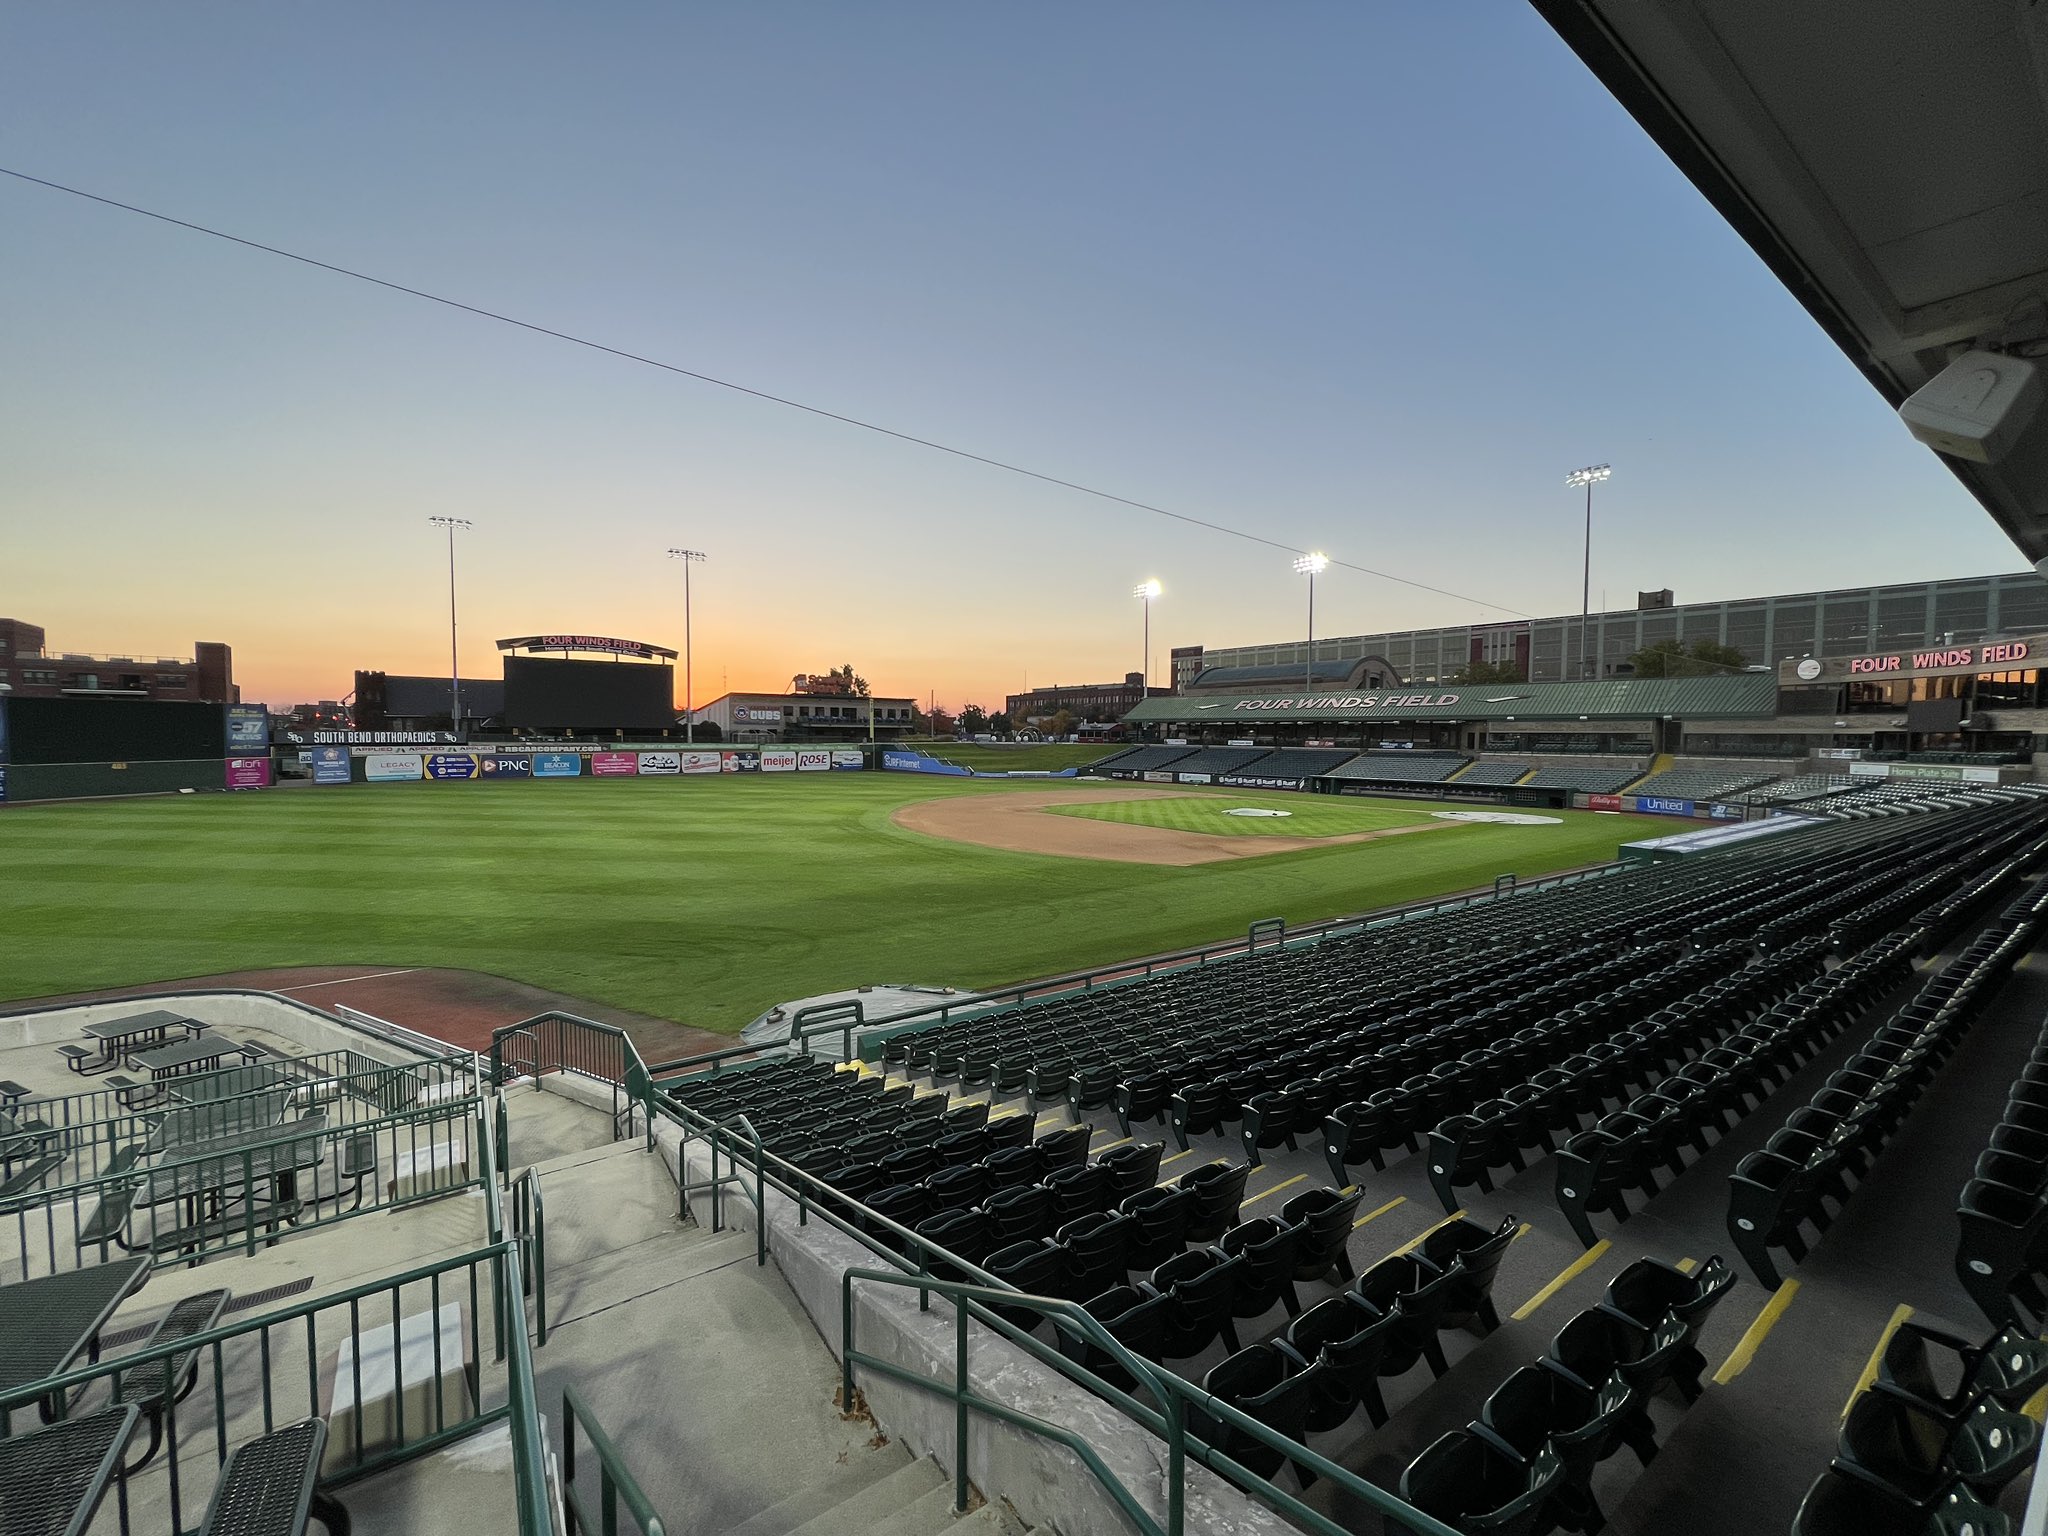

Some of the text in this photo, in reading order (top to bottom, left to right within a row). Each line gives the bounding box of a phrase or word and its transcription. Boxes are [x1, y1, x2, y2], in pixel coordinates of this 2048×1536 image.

[543, 636, 641, 650] FOUR WINDS FIELD
[1851, 643, 2028, 673] FOUR WINDS FIELD
[1233, 694, 1460, 711] FOUR WINDS FIELD
[750, 710, 781, 720] CUBS
[242, 721, 263, 733] 57
[232, 733, 262, 741] NEWS
[287, 731, 304, 744] SBO
[313, 731, 345, 744] SOUTH
[347, 731, 372, 743] BEND
[374, 731, 436, 743] ORTHOPAEDICS
[380, 761, 416, 769] LEGACY
[498, 760, 529, 771] PNC
[763, 755, 795, 767] meijer
[799, 754, 828, 767] ROSE
[1892, 768, 1961, 778] Home Plate Suite
[1646, 798, 1683, 811] United
